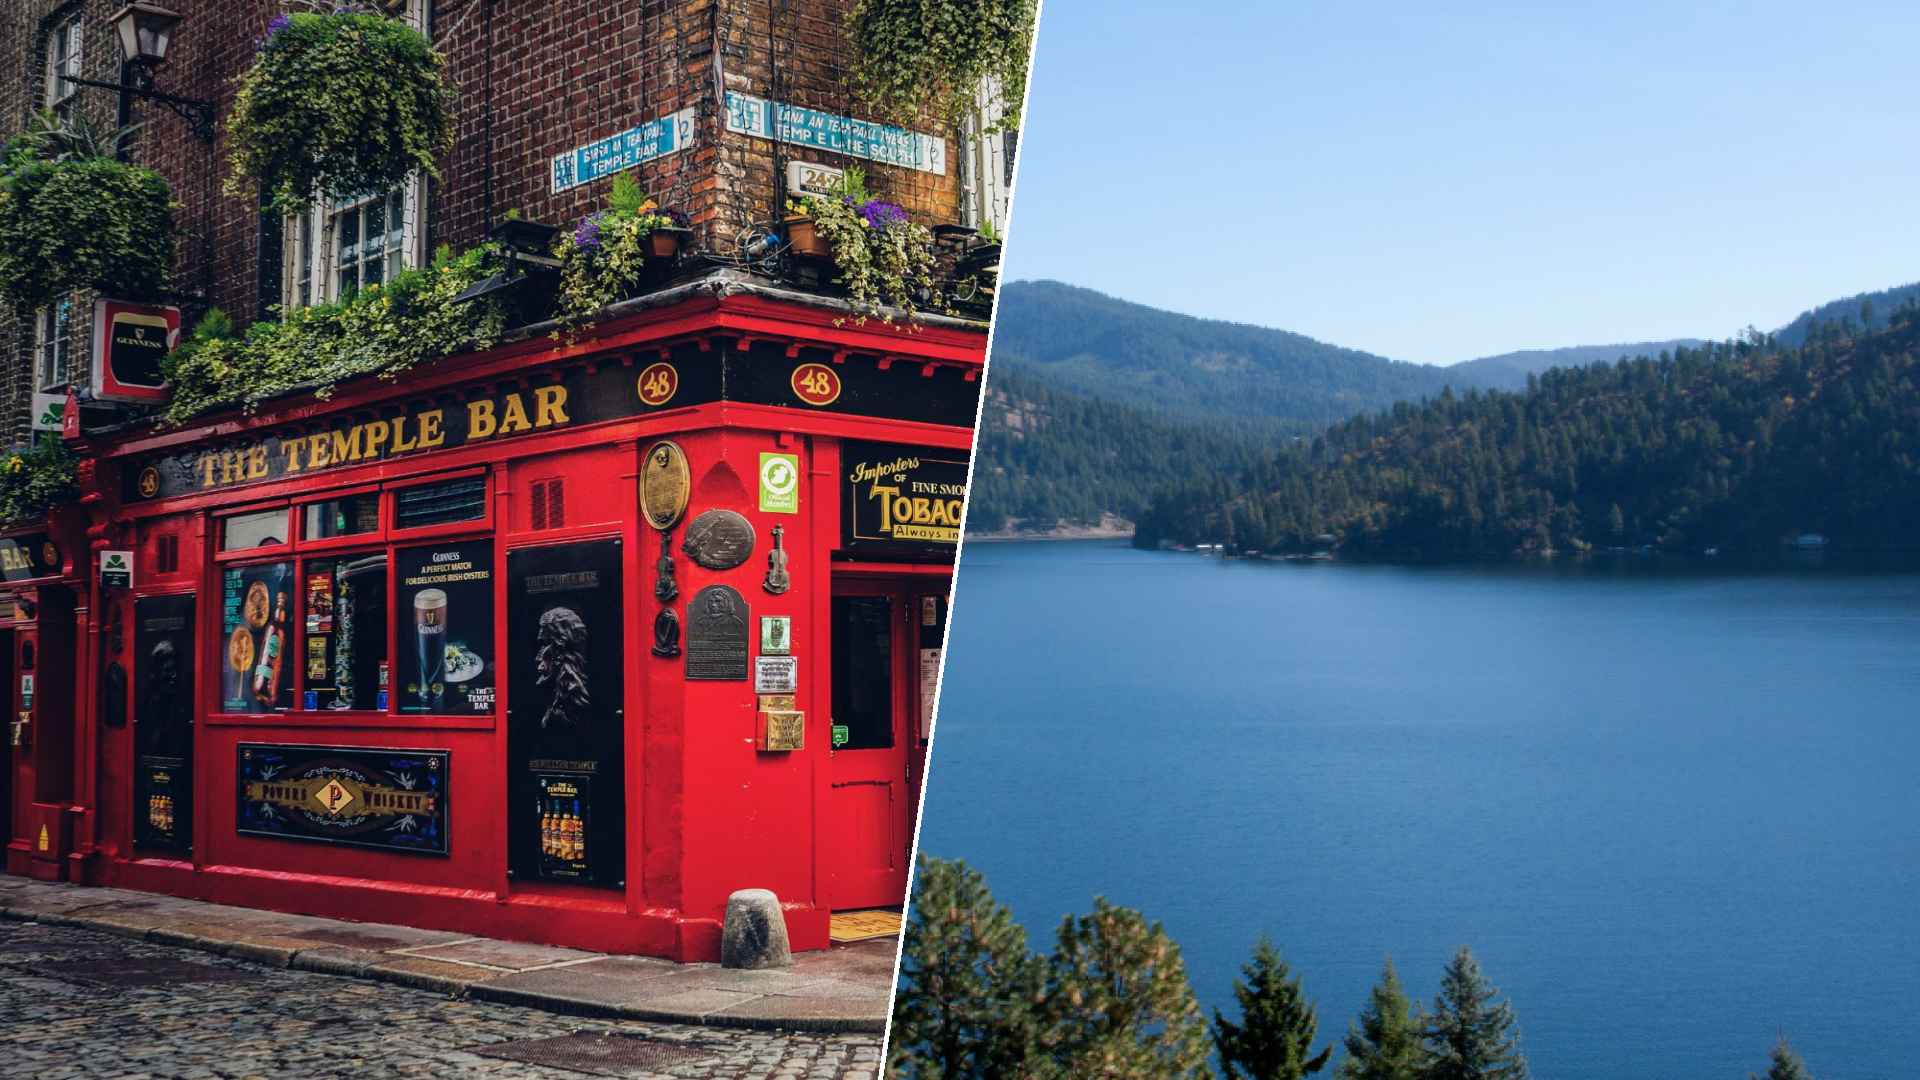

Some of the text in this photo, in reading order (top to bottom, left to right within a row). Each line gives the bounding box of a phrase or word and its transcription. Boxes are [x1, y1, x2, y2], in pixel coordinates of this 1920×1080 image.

[681, 120, 689, 141] 2
[808, 115, 824, 129] AN
[776, 123, 827, 145] TEMPE
[591, 151, 632, 174] TEMPLE
[116, 336, 162, 349] GUINNESS
[644, 370, 671, 398] 48
[800, 369, 831, 395] 48
[198, 384, 570, 487] THE TEMPLE BAR
[850, 457, 920, 486] Importers
[894, 474, 907, 482] OF
[911, 482, 938, 493] FINE
[896, 526, 941, 538] Always
[1, 547, 35, 570] BAR
[432, 552, 460, 563] GUINNESS
[426, 564, 450, 573] PERFECT
[467, 694, 496, 702] TEMPLE
[474, 702, 489, 710] BAR
[262, 784, 422, 810] POWERS P WHISKEY
